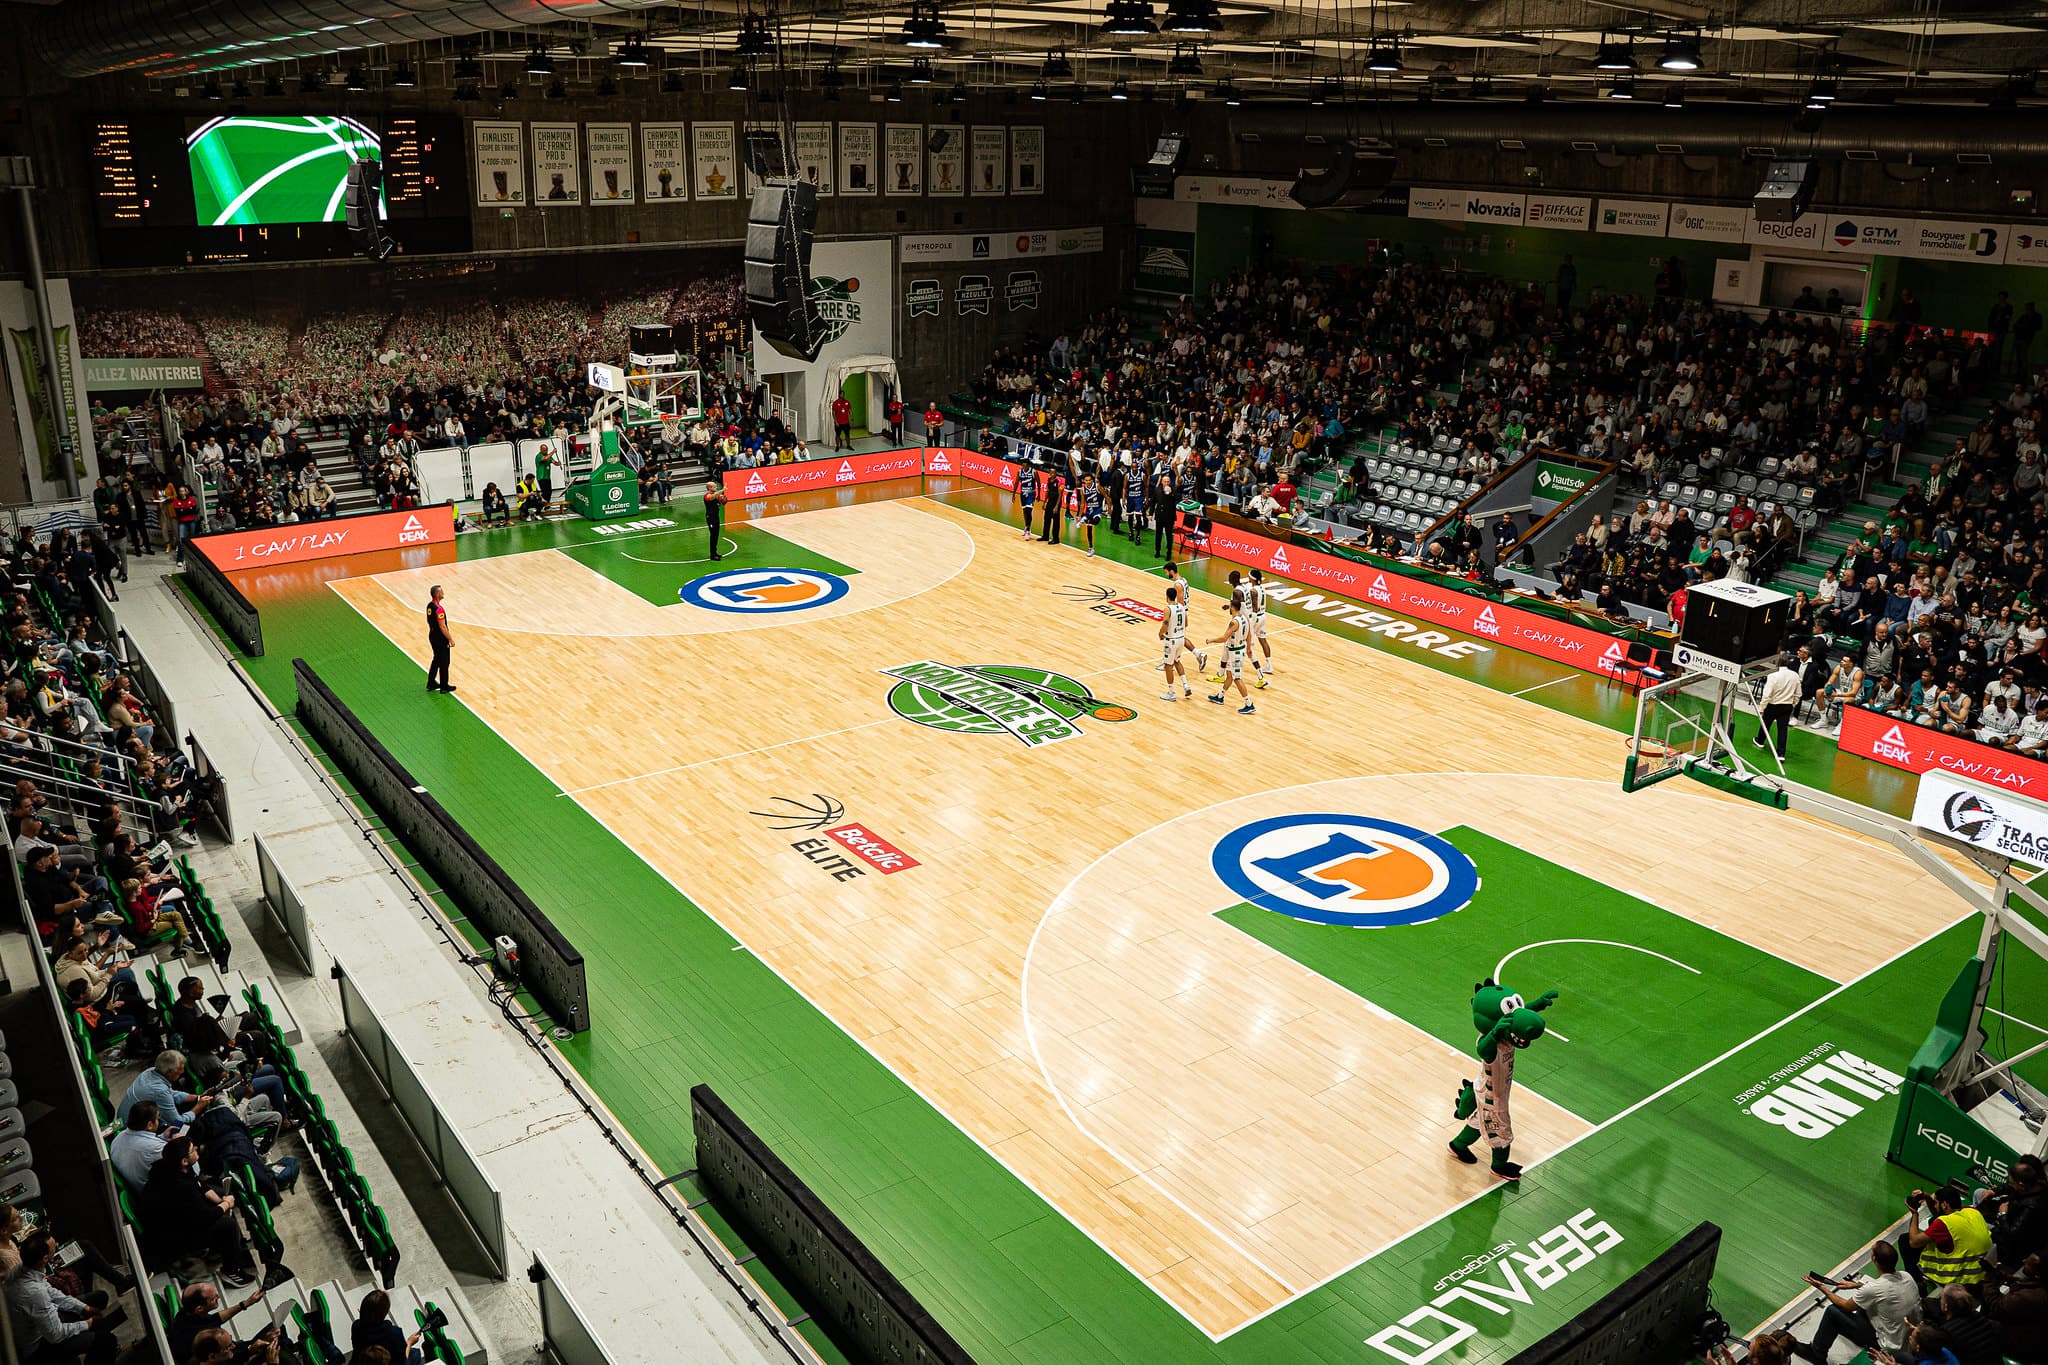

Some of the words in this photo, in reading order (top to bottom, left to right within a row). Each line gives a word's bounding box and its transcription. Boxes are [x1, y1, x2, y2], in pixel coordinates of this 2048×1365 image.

[483, 132, 514, 142] FINALISTE
[538, 131, 571, 141] CHAMPION
[594, 134, 624, 142] FINALISTE
[648, 131, 678, 140] CHAMPION
[700, 131, 728, 140] FINALISTE
[548, 141, 572, 150] FRANCE
[658, 140, 679, 149] FRANCE
[546, 151, 560, 160] PRO
[655, 150, 666, 158] PRO
[1467, 198, 1521, 219] Novaxia
[1544, 204, 1584, 217] EIFFAGE
[1686, 217, 1704, 230] OGIC
[1863, 227, 1898, 238] GTM
[1922, 230, 1965, 242] Bouygues
[1920, 239, 1967, 250] Immobilier
[846, 304, 860, 320] 92
[57, 344, 76, 412] NANTERRE
[87, 368, 128, 382] ALLEZ
[130, 366, 202, 381] NANTERRE!
[930, 462, 952, 471] PEAK
[966, 462, 982, 471] CAN
[980, 464, 995, 476] PLAY
[744, 482, 768, 494] PEAK
[780, 474, 803, 484] CAN
[801, 470, 828, 480] PLAY
[836, 471, 856, 482] PEAK
[872, 462, 894, 472] CAN
[892, 458, 917, 468] PLAY
[602, 502, 630, 511] E.Leclerc
[251, 538, 297, 556] CAN
[300, 529, 350, 550] PLAY
[398, 530, 430, 542] PEAK
[1220, 540, 1241, 550] CAN
[1241, 544, 1263, 557] PLAY
[1270, 559, 1291, 574] PEAK
[1309, 566, 1333, 577] CAN
[1332, 571, 1358, 584] PLAY
[1368, 588, 1392, 604] PEAK
[1410, 596, 1435, 608] CAN
[1436, 602, 1465, 616] PLAY
[1473, 620, 1500, 637] PEAK
[1524, 630, 1552, 642] CAN
[1552, 636, 1585, 652] PLAY
[1692, 656, 1736, 676] IMMOBEL
[888, 662, 1046, 722] NANTERRE
[1017, 718, 1073, 745] 92
[1872, 740, 1913, 765] PEAK
[1940, 756, 1982, 773] CAN
[1982, 766, 2035, 788] PLAY
[833, 828, 904, 869] Betclic
[790, 838, 867, 882] ÉLITE
[1810, 1041, 1836, 1058] LIGUE
[1768, 1054, 1814, 1082] NATIONALE
[1732, 1083, 1766, 1105] BASKET
[1433, 1240, 1517, 1292] NETOGROUP
[1362, 1207, 1625, 1365] SERALCO
